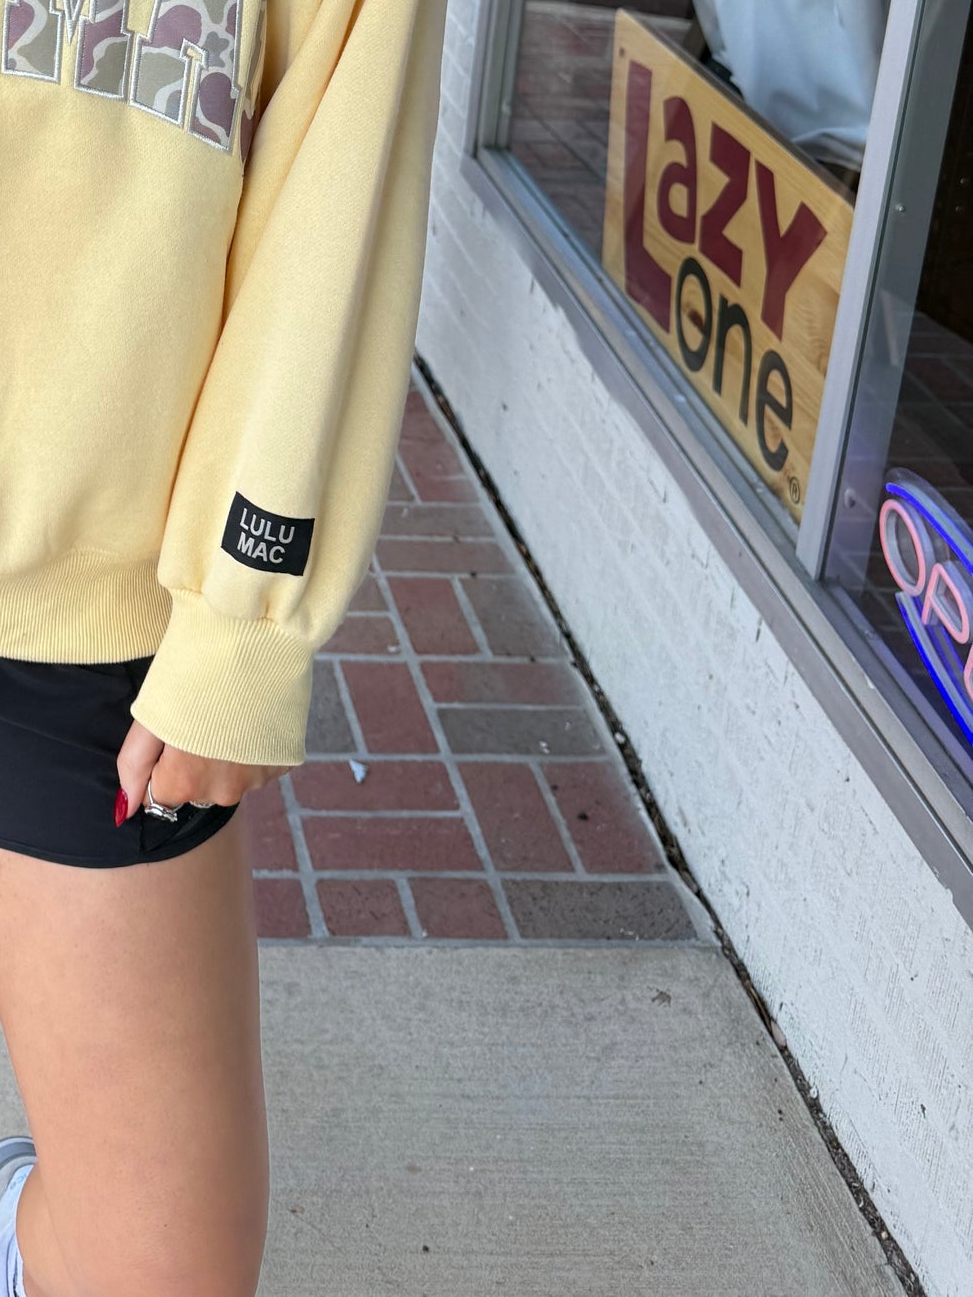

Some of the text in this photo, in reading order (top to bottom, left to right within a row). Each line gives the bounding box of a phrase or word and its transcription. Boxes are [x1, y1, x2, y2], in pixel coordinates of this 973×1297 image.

[239, 507, 295, 544] LULU
[236, 531, 286, 564] MAC
[879, 498, 973, 701] OP
